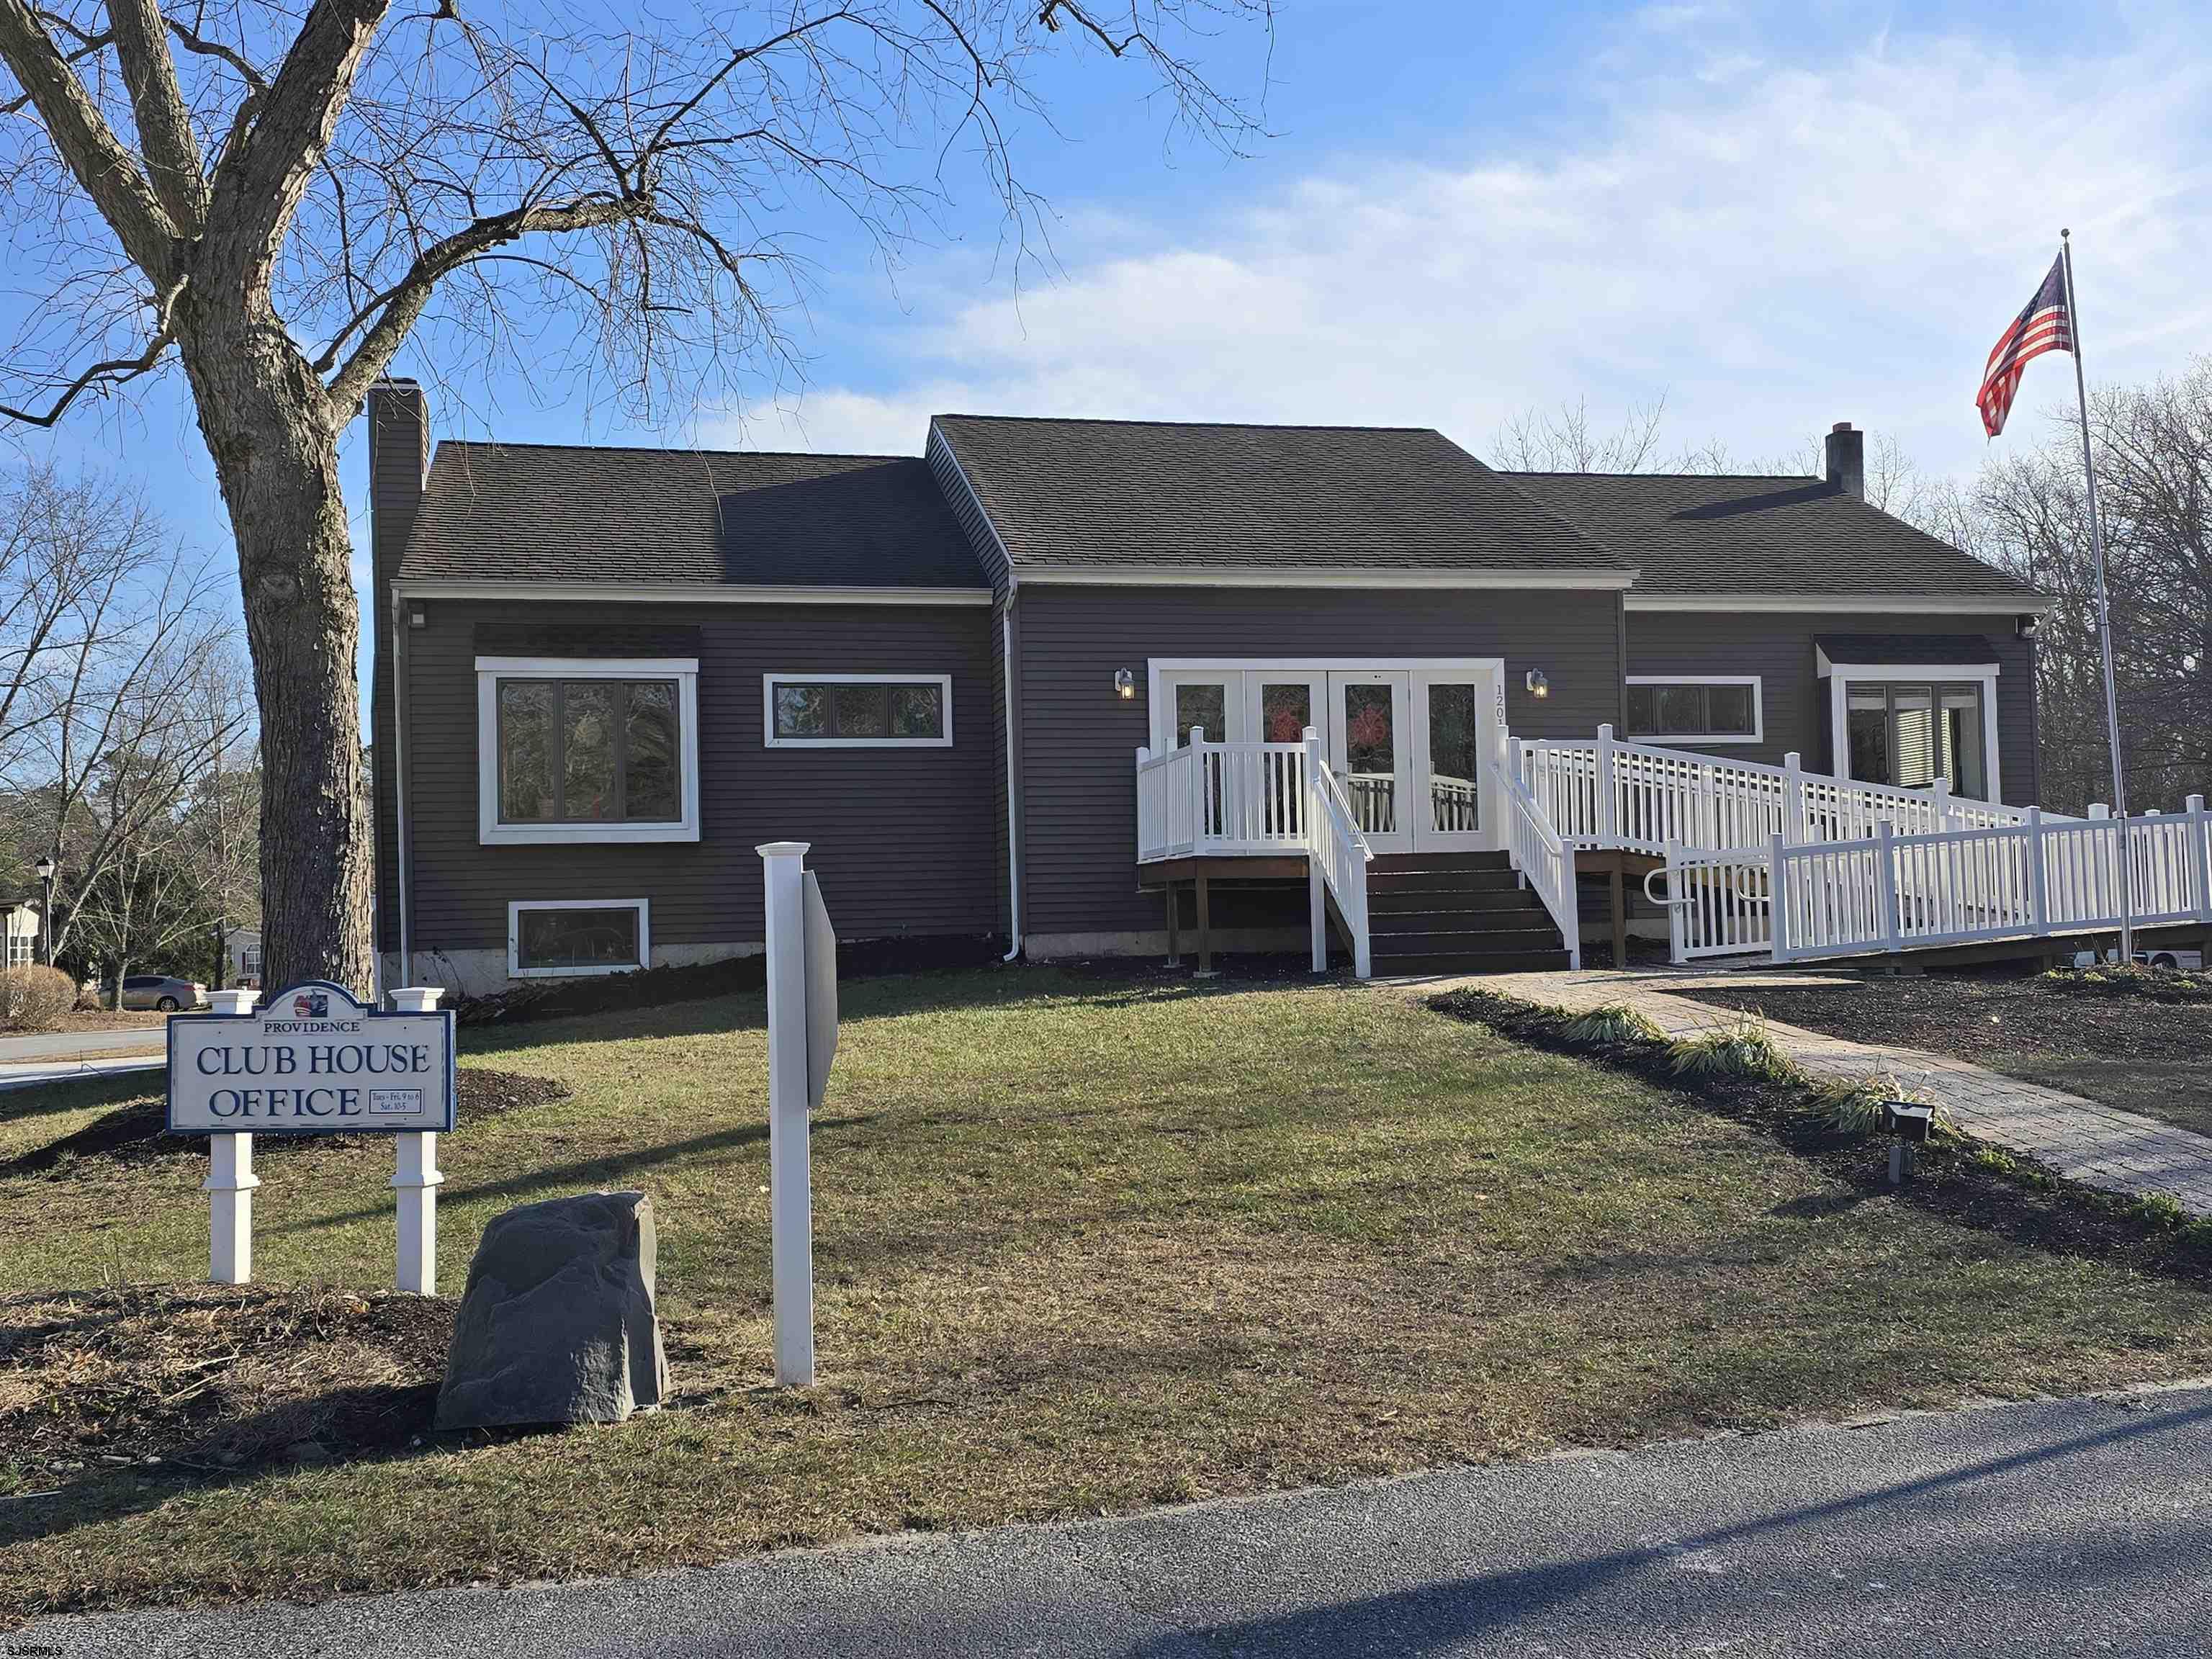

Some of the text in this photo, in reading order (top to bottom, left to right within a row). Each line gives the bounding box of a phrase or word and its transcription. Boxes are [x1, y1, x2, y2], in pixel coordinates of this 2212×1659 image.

[264, 1022, 360, 1033] PROVIDENCE
[197, 1045, 431, 1074] CLUB HOUSE
[209, 1089, 361, 1117] OFFICE
